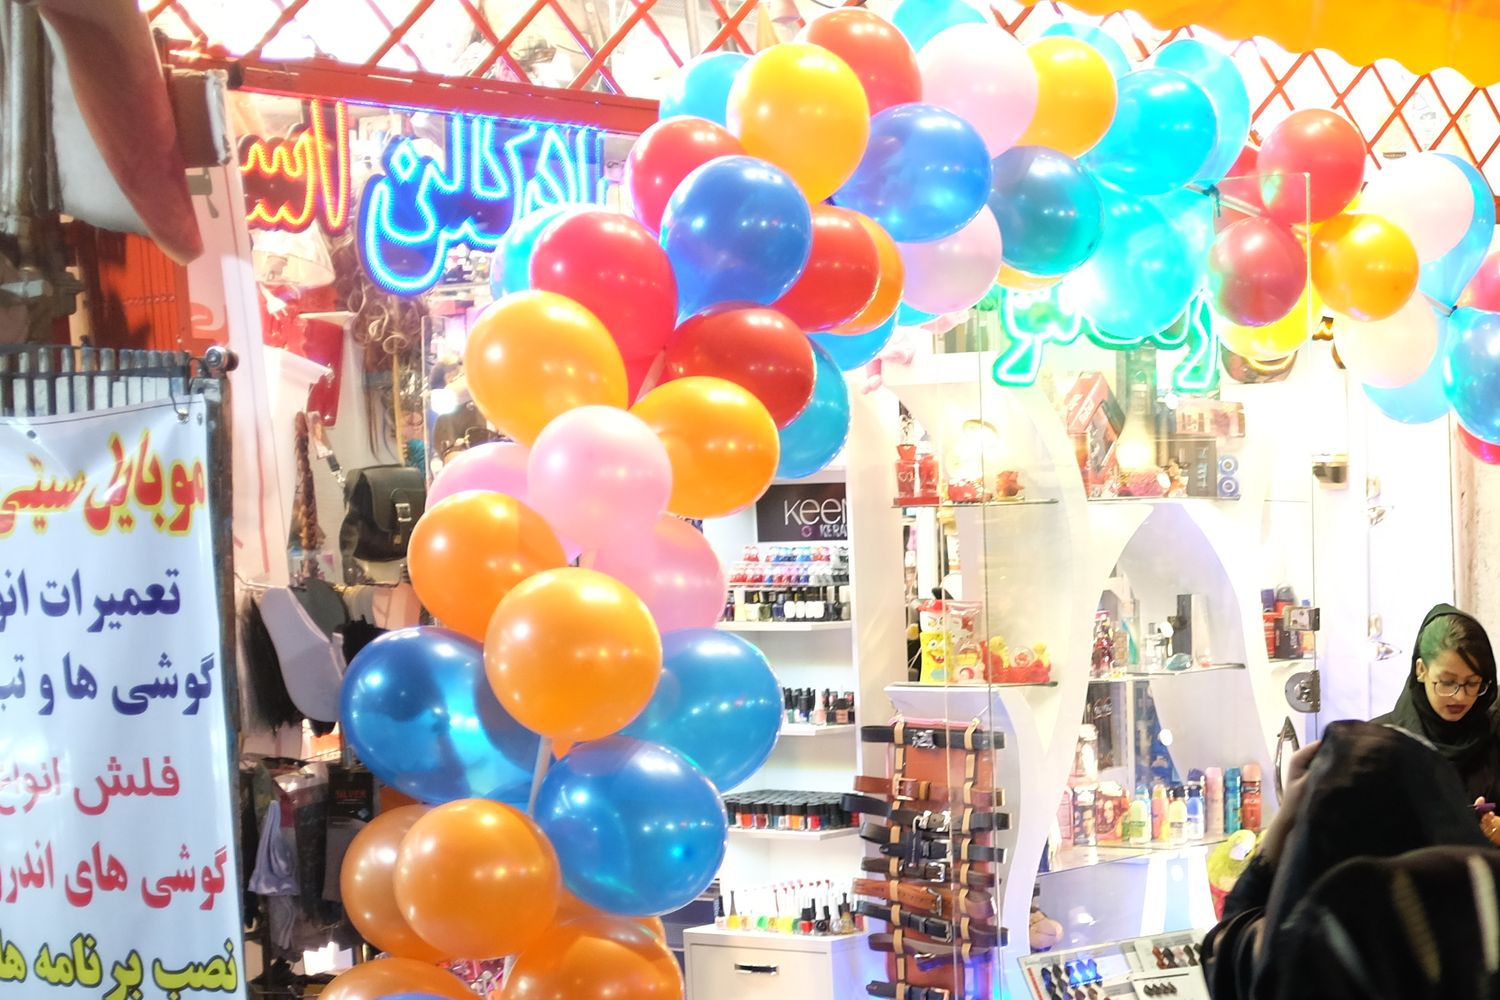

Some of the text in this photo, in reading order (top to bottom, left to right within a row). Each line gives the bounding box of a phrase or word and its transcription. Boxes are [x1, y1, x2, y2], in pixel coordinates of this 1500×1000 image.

[83, 427, 207, 538] موبایل
[39, 567, 181, 633] تعمیرات
[37, 673, 55, 716] و
[61, 651, 98, 700] ها
[111, 651, 215, 716] گوشی
[72, 755, 180, 816] فلش
[64, 841, 129, 909] های
[141, 842, 228, 911] گوشی
